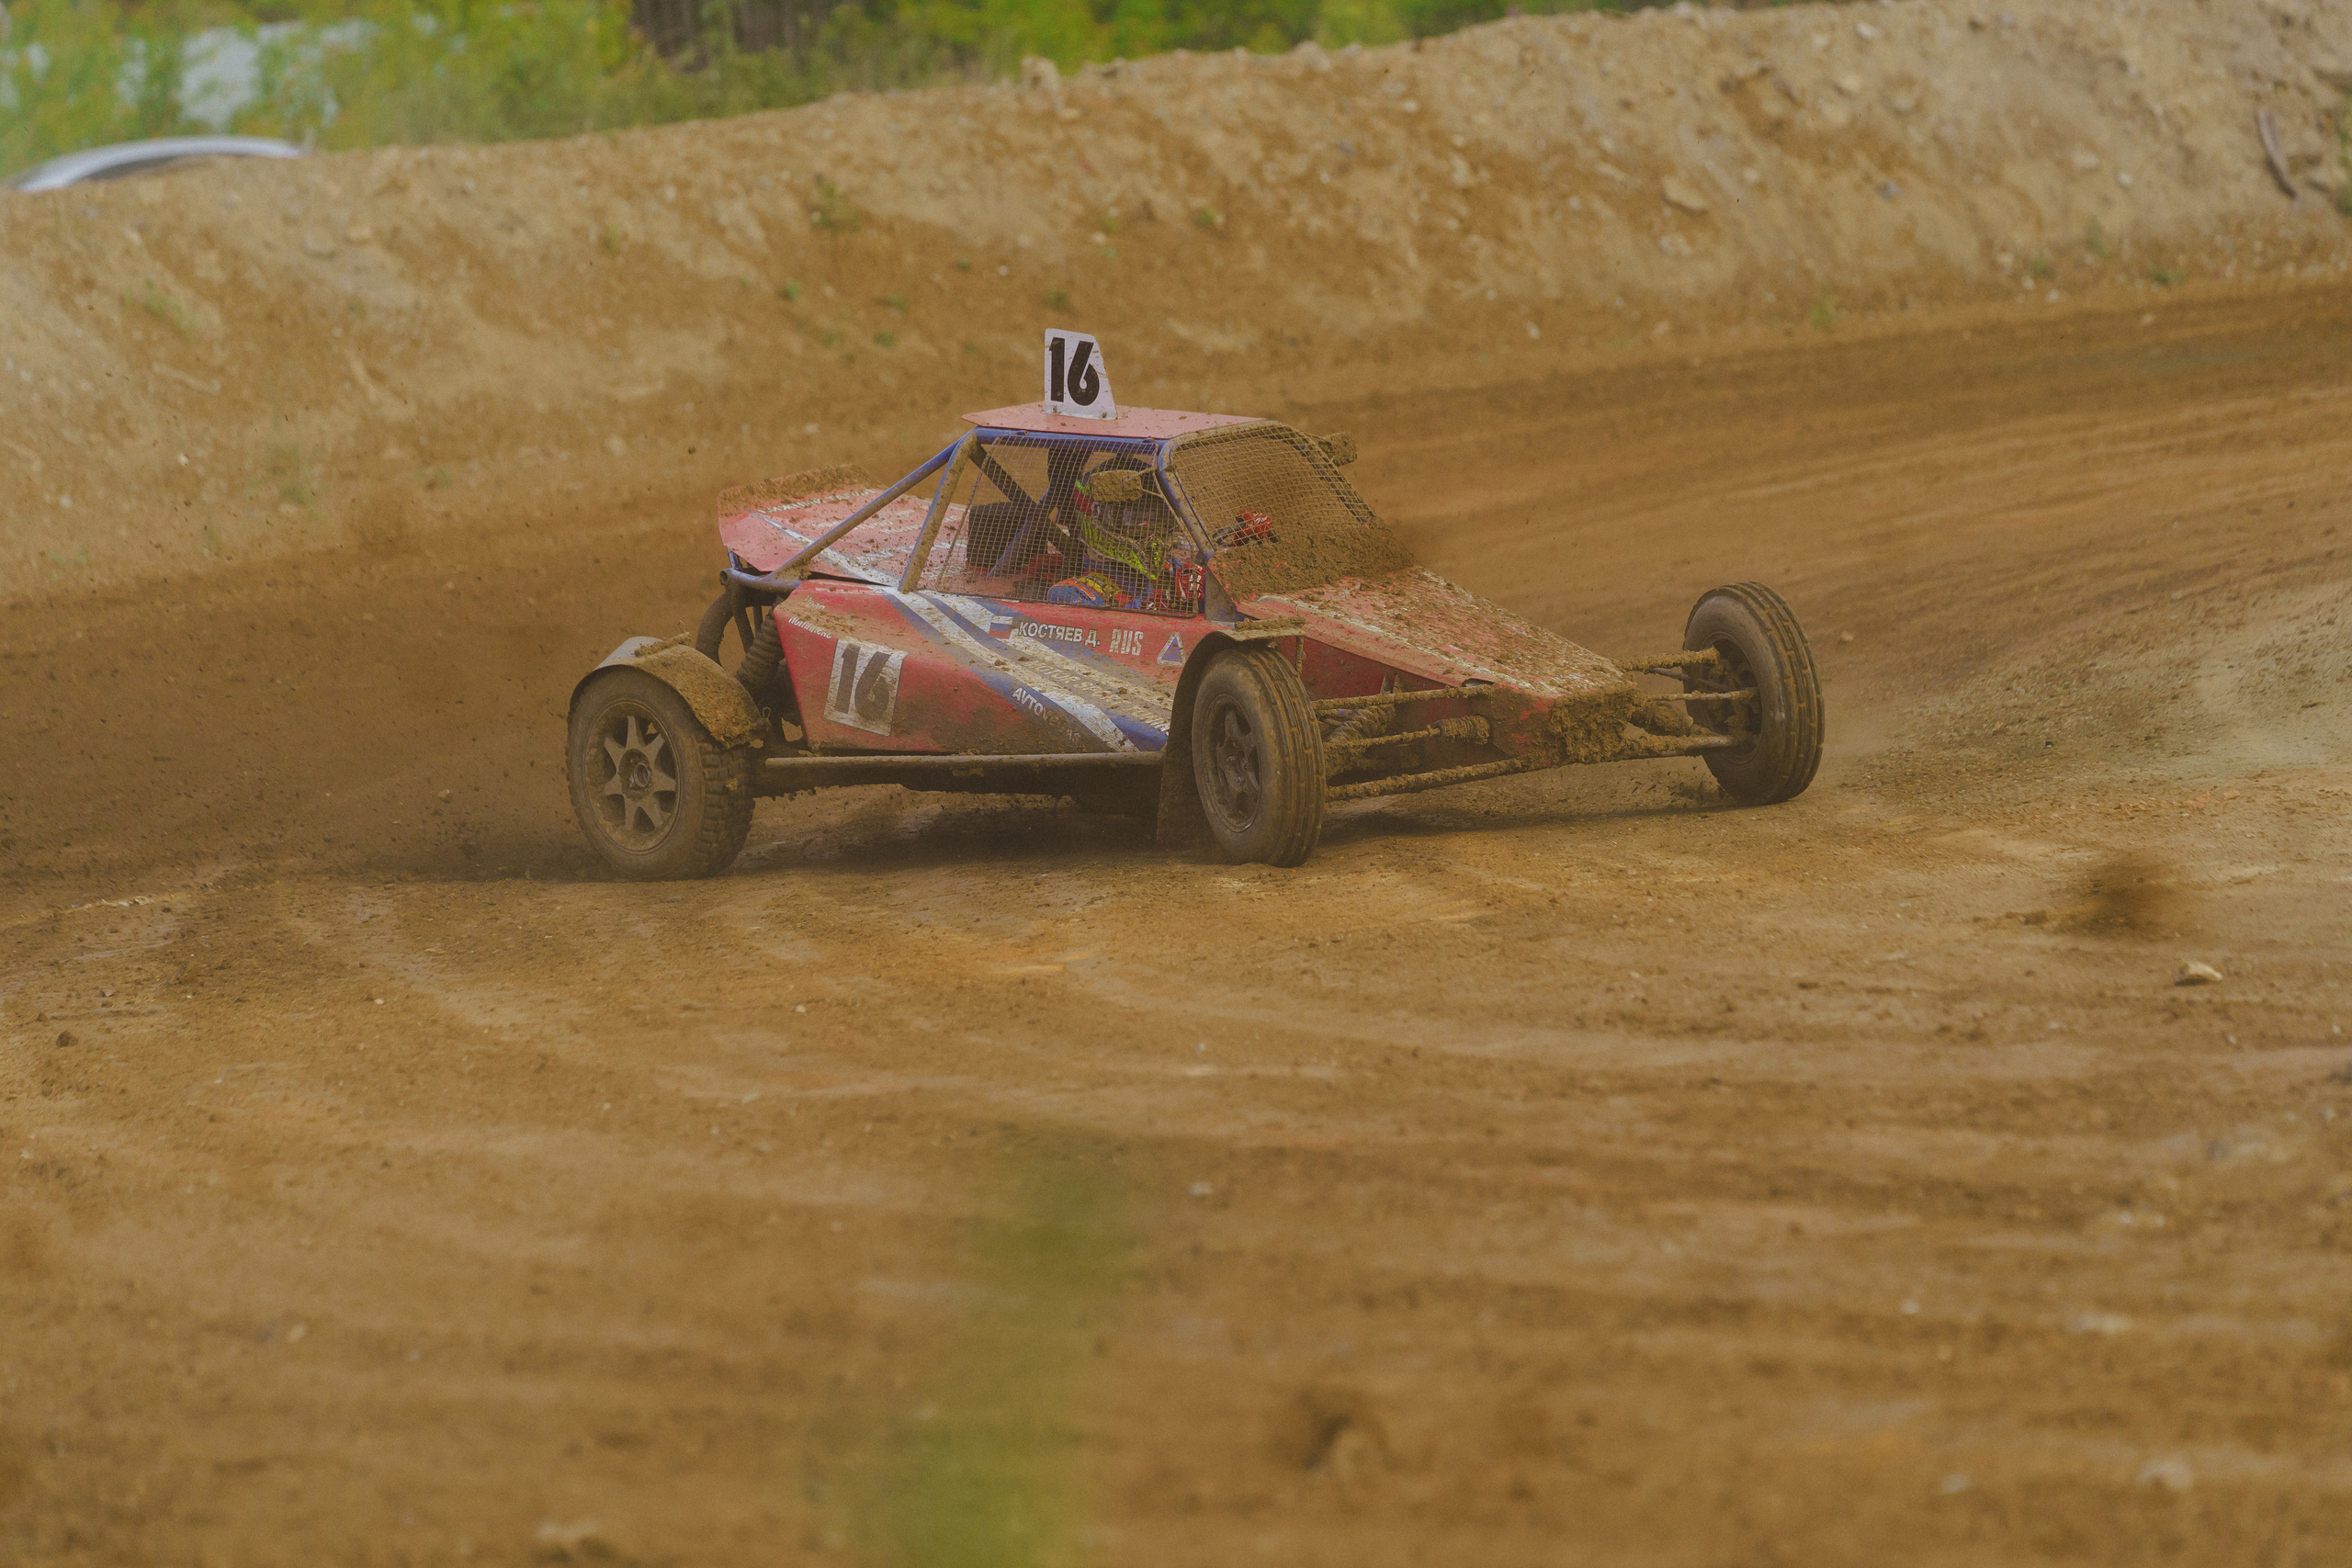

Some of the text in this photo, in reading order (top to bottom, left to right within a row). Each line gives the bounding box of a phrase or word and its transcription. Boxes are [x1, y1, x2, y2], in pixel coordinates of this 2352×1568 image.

[1048, 336, 1101, 407] 16
[1017, 621, 1101, 648] КОСТЯЕВ Д.
[1108, 627, 1144, 657] RUS
[834, 643, 892, 722] 16
